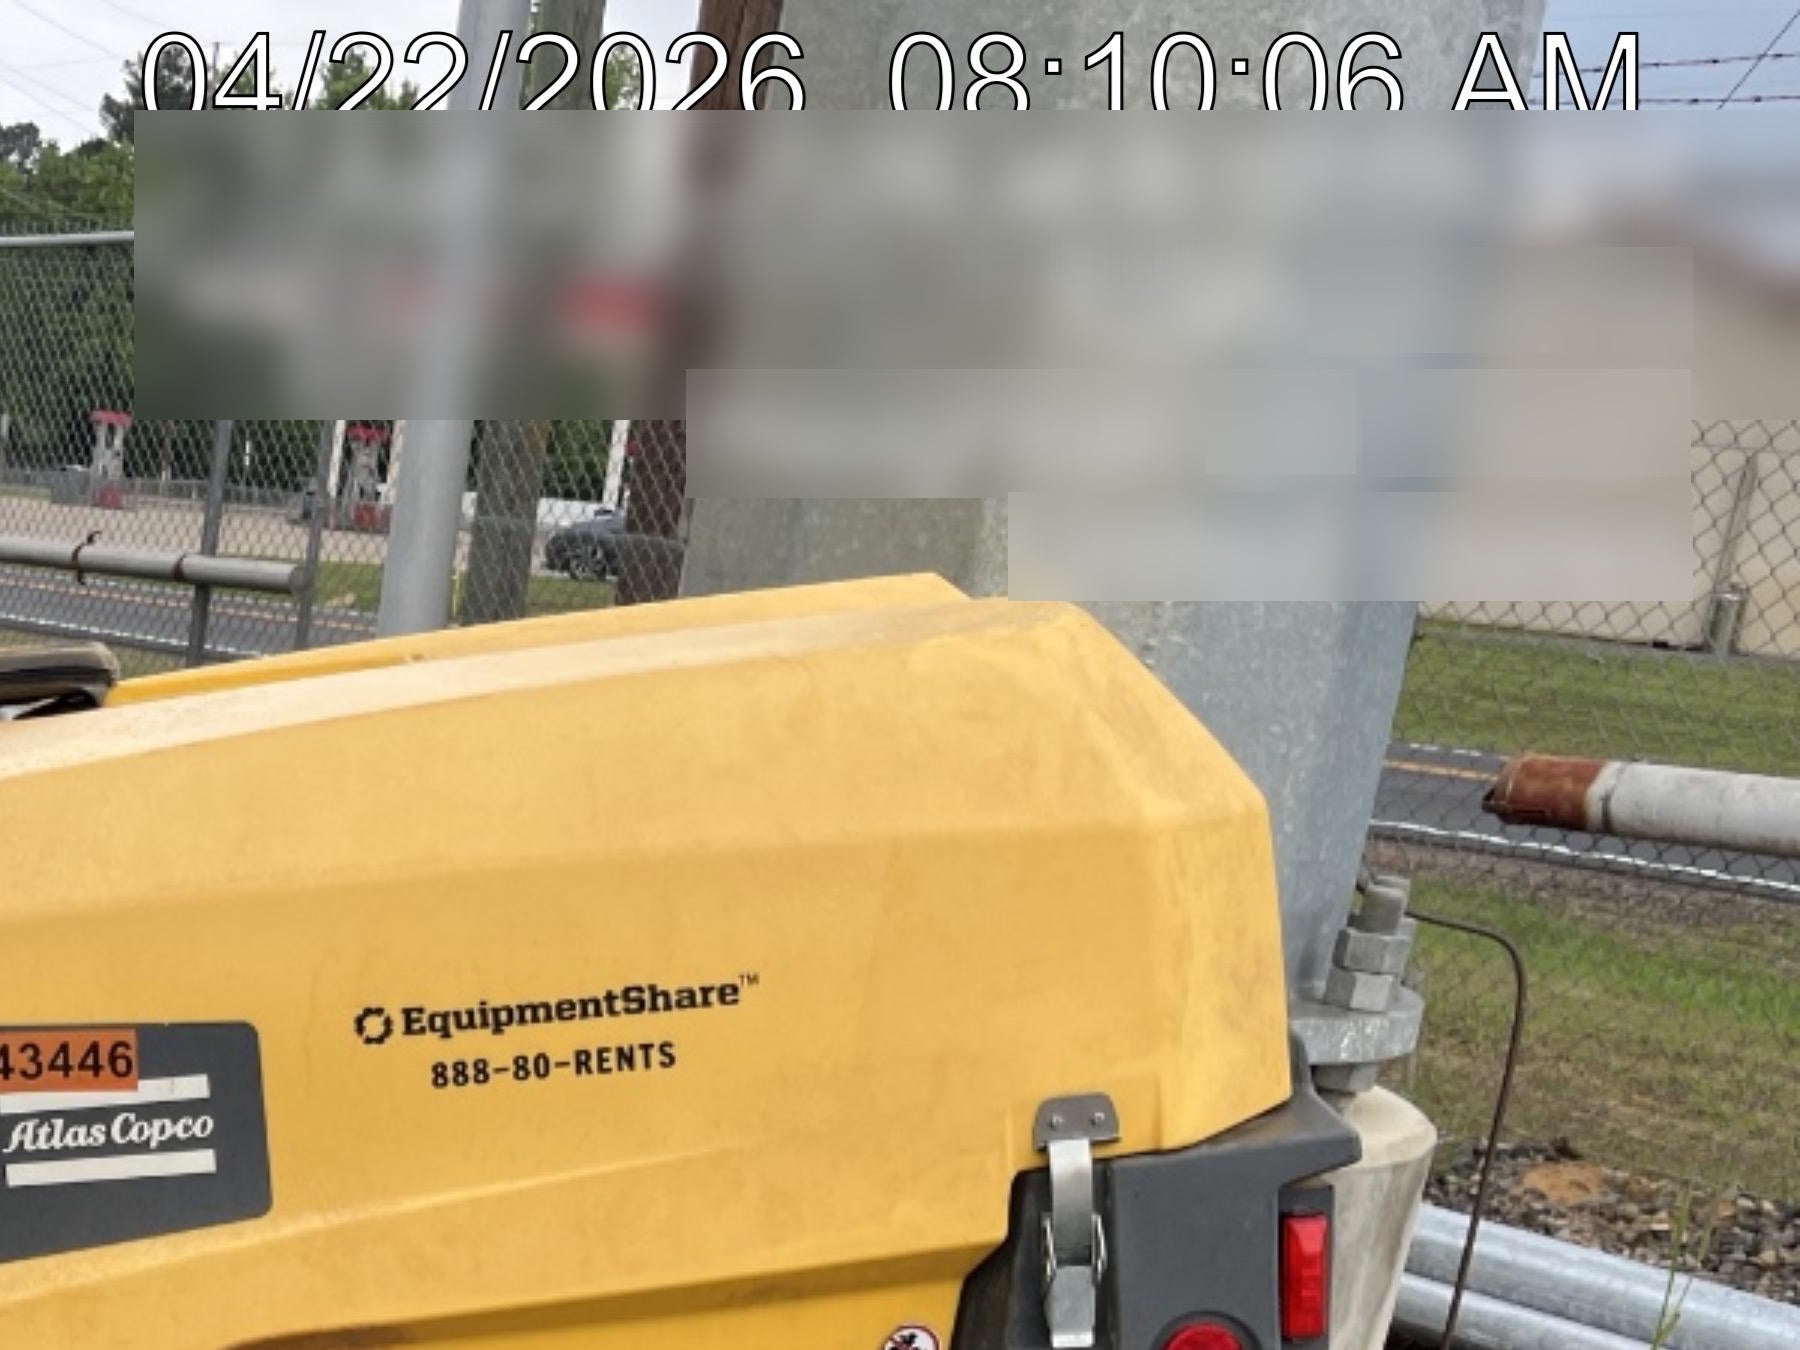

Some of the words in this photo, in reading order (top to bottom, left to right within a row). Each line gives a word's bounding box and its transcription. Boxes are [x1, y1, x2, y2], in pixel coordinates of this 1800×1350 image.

[430, 1041, 677, 1089] 888-80-RENTS
[3, 1117, 107, 1153] Atlas
[110, 1111, 214, 1148] Copco
